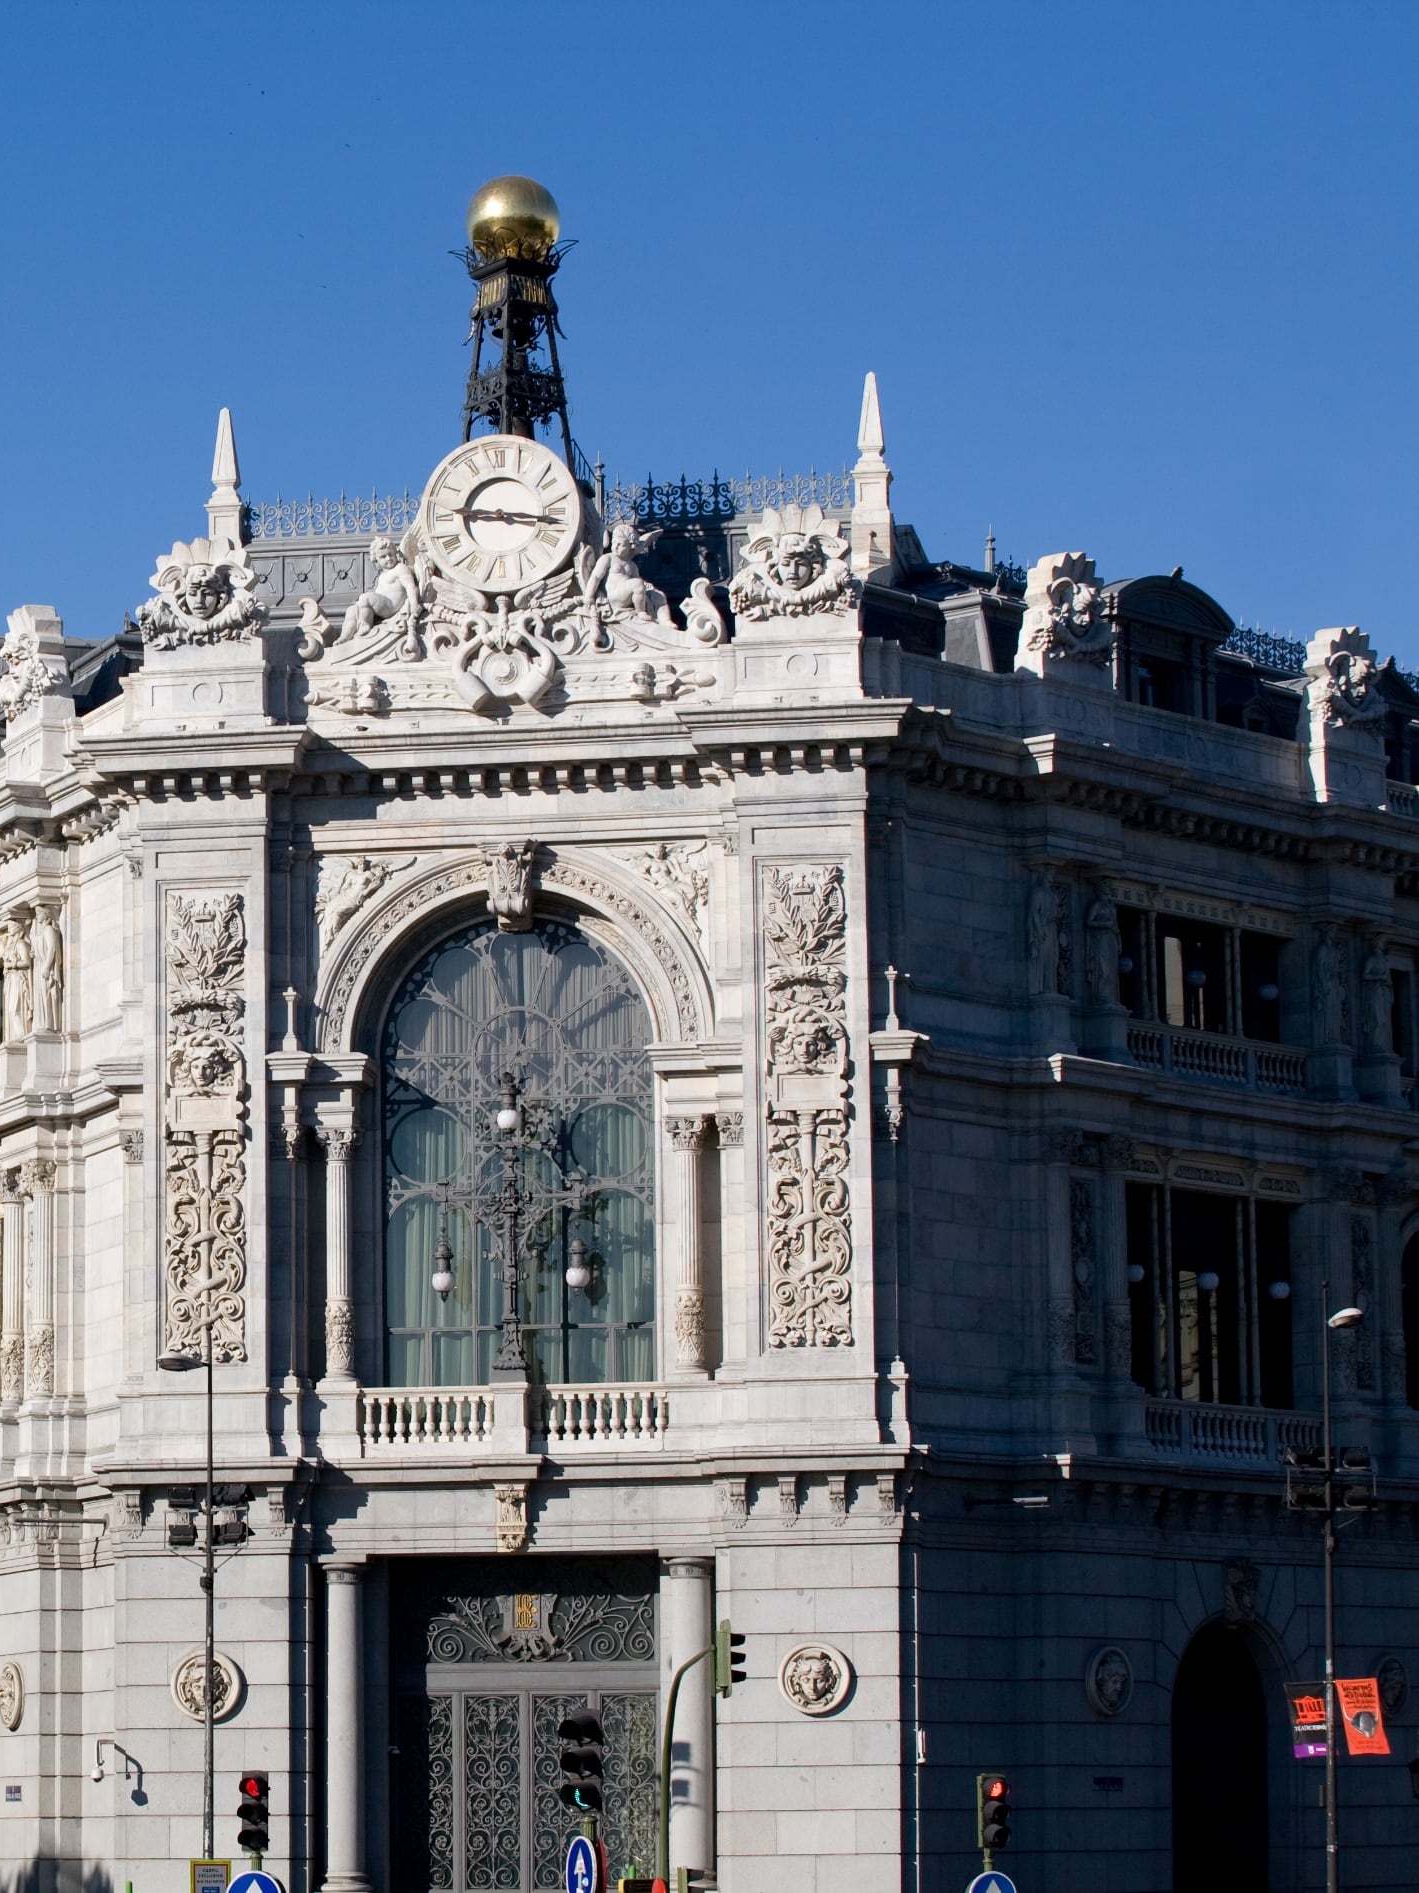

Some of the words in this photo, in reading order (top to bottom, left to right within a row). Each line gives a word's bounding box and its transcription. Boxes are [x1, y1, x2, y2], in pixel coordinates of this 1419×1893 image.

[464, 458, 480, 477] XI
[494, 450, 506, 469] XII
[541, 477, 557, 491] II
[547, 507, 566, 517] III
